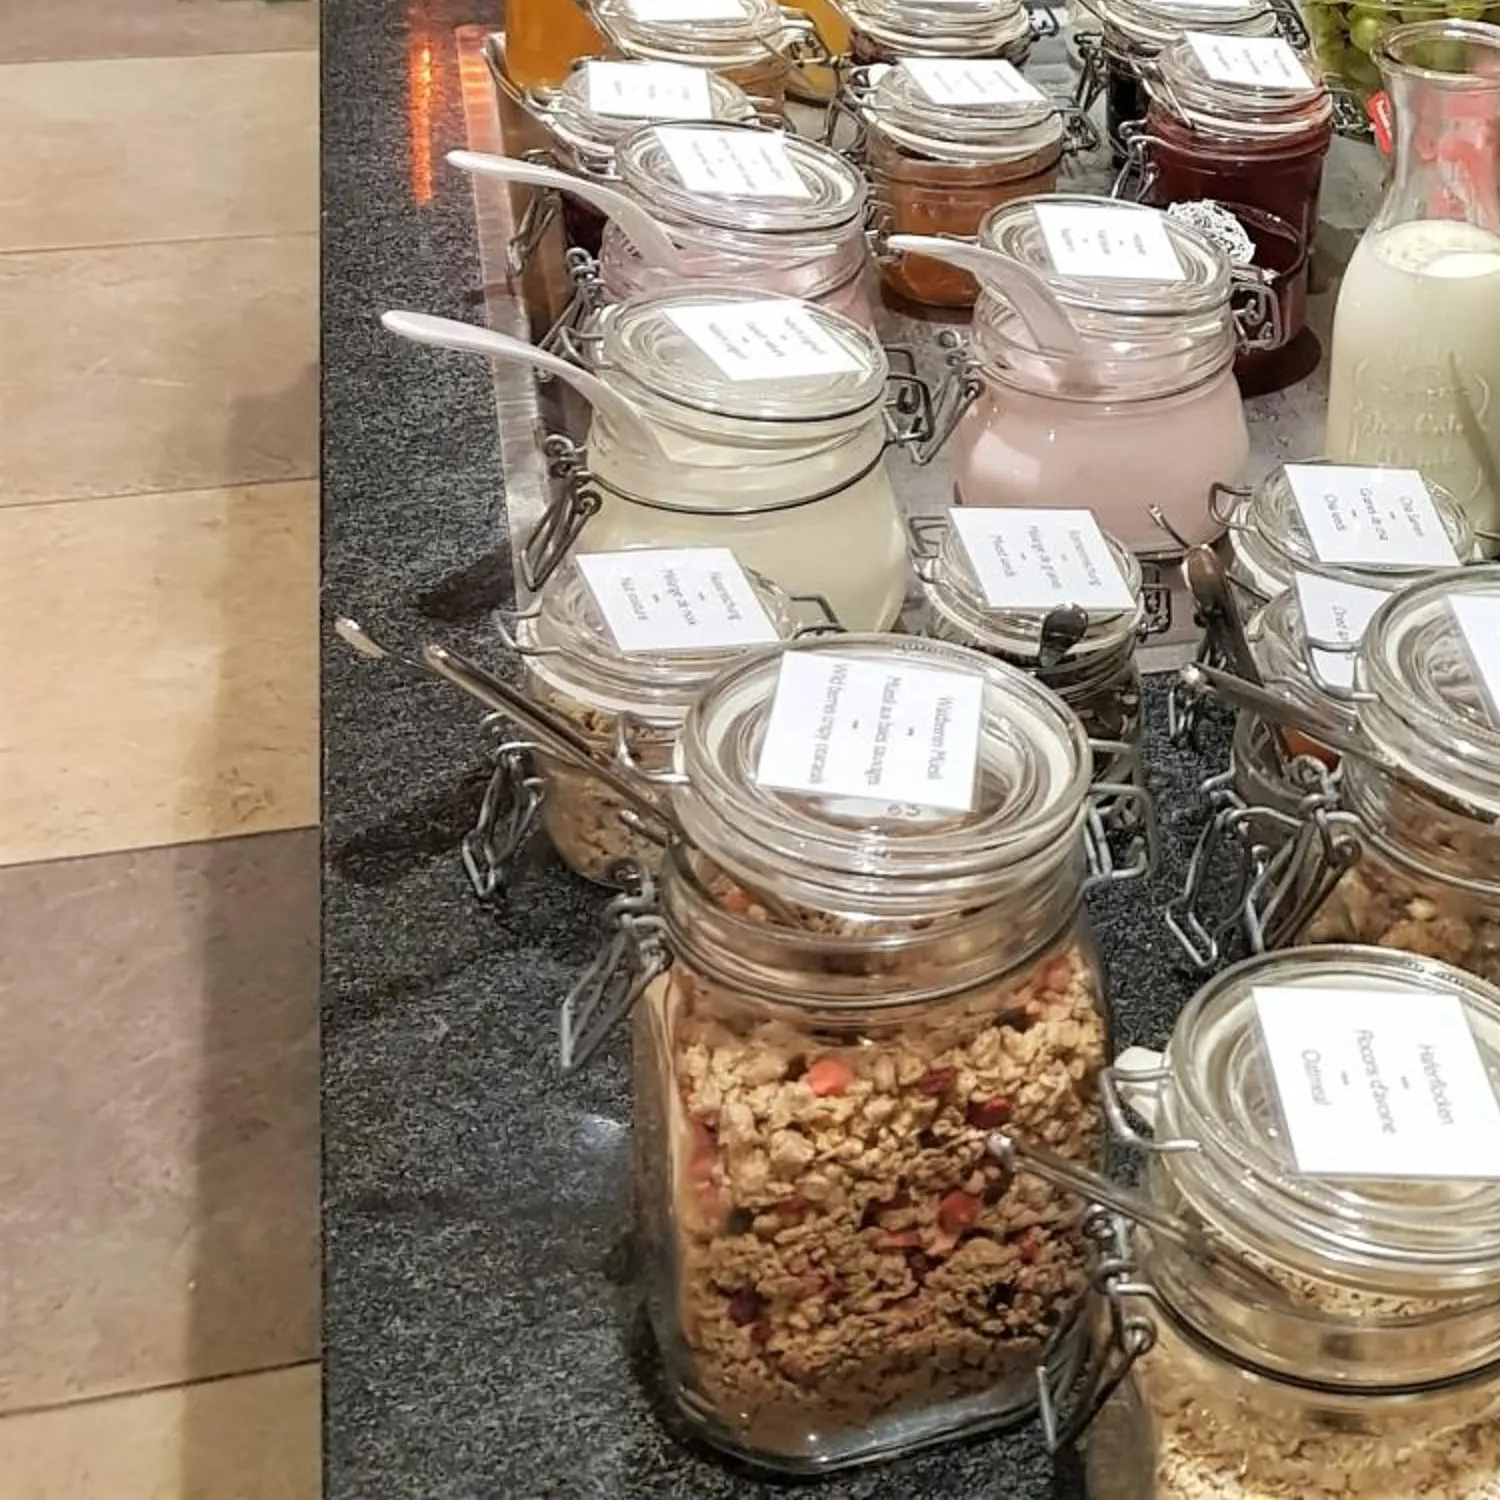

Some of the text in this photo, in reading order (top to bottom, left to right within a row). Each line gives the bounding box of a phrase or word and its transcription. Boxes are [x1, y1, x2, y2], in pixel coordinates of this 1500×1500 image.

[1301, 1049, 1332, 1106] Oatmeal
[1418, 1044, 1454, 1124] Haferflocken
[1370, 1080, 1397, 1135] d'avoine
